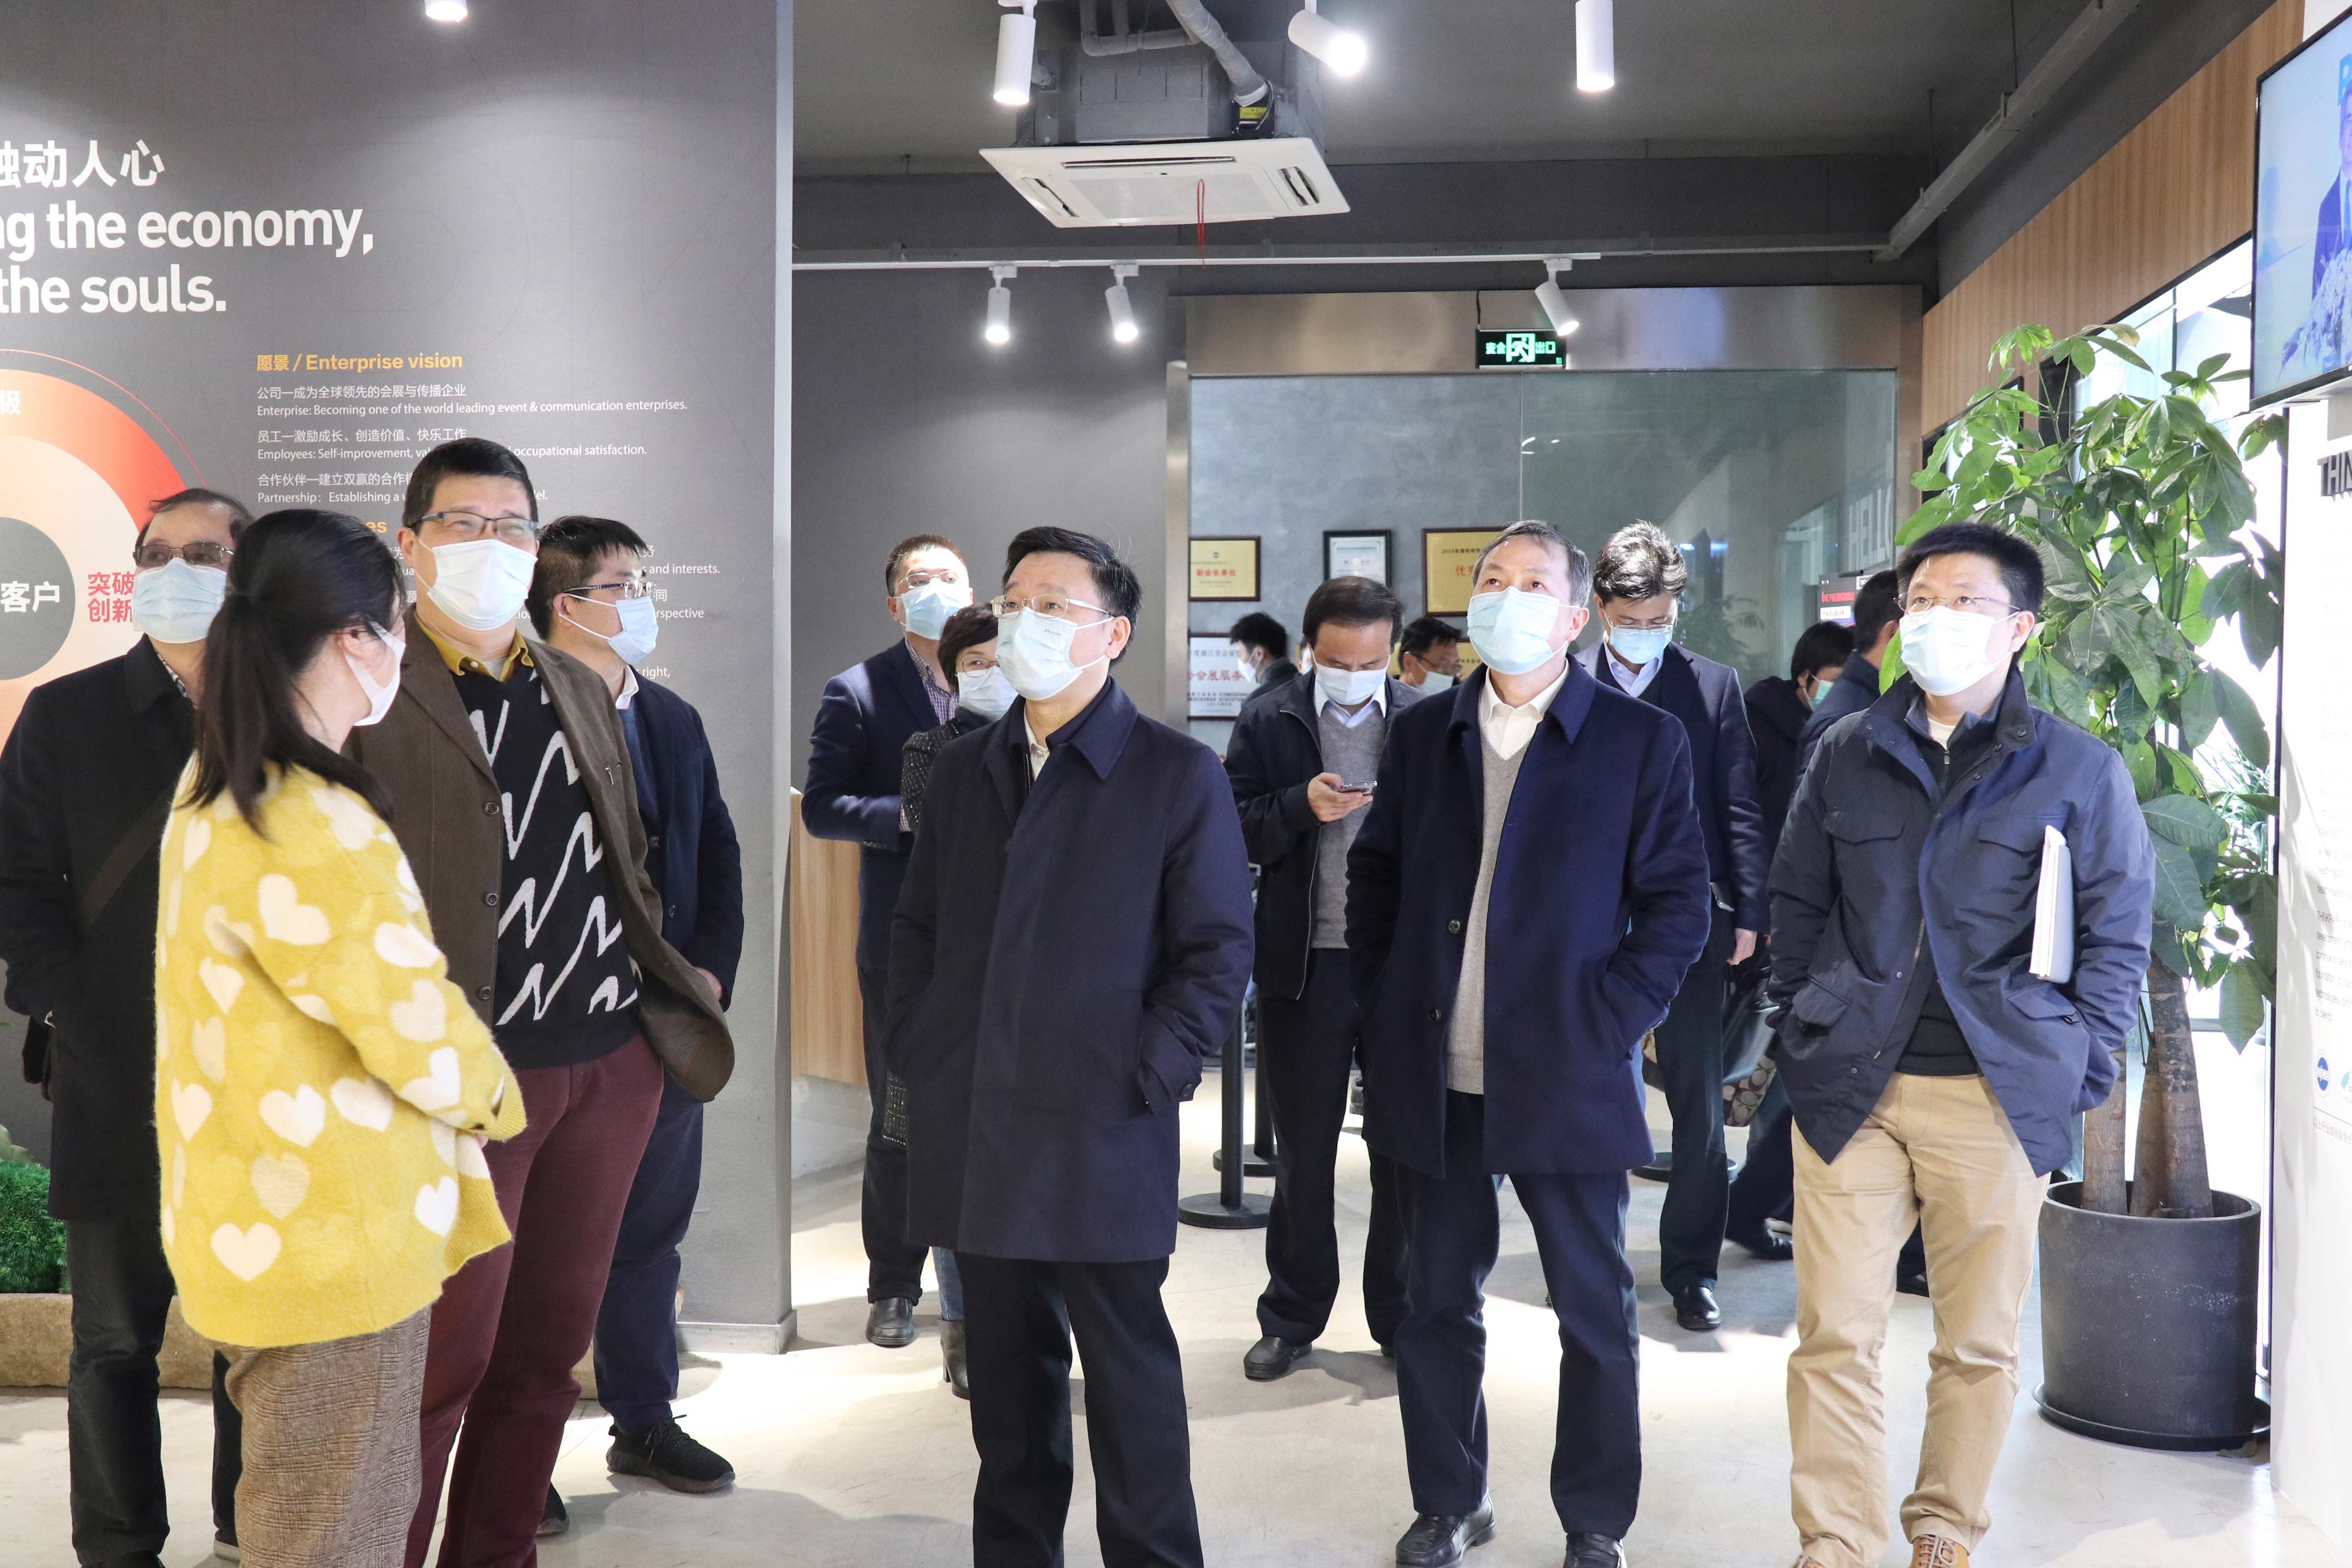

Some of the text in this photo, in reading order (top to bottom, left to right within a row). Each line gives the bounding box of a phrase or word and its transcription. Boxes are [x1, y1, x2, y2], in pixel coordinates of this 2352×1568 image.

[46, 200, 126, 249] the
[138, 208, 374, 257] economy,
[80, 263, 226, 312] souls.
[256, 354, 289, 372] 愿景
[306, 353, 404, 374] Enterprise
[407, 352, 463, 369] vision
[257, 398, 688, 418] Enterprise: Becoming one of the world leading event & communication enterprises.
[257, 448, 316, 462] Employees:
[318, 447, 413, 461] Self-improvement,
[513, 444, 582, 459] occupational
[584, 443, 648, 456] satisfaction.
[329, 490, 391, 505] Establishing
[393, 494, 400, 502] a
[649, 563, 669, 574] and
[672, 563, 720, 574] interests.
[88, 571, 135, 596] 突破
[0, 581, 60, 613] 客户
[88, 598, 133, 623] 创新
[642, 665, 671, 680] right,
